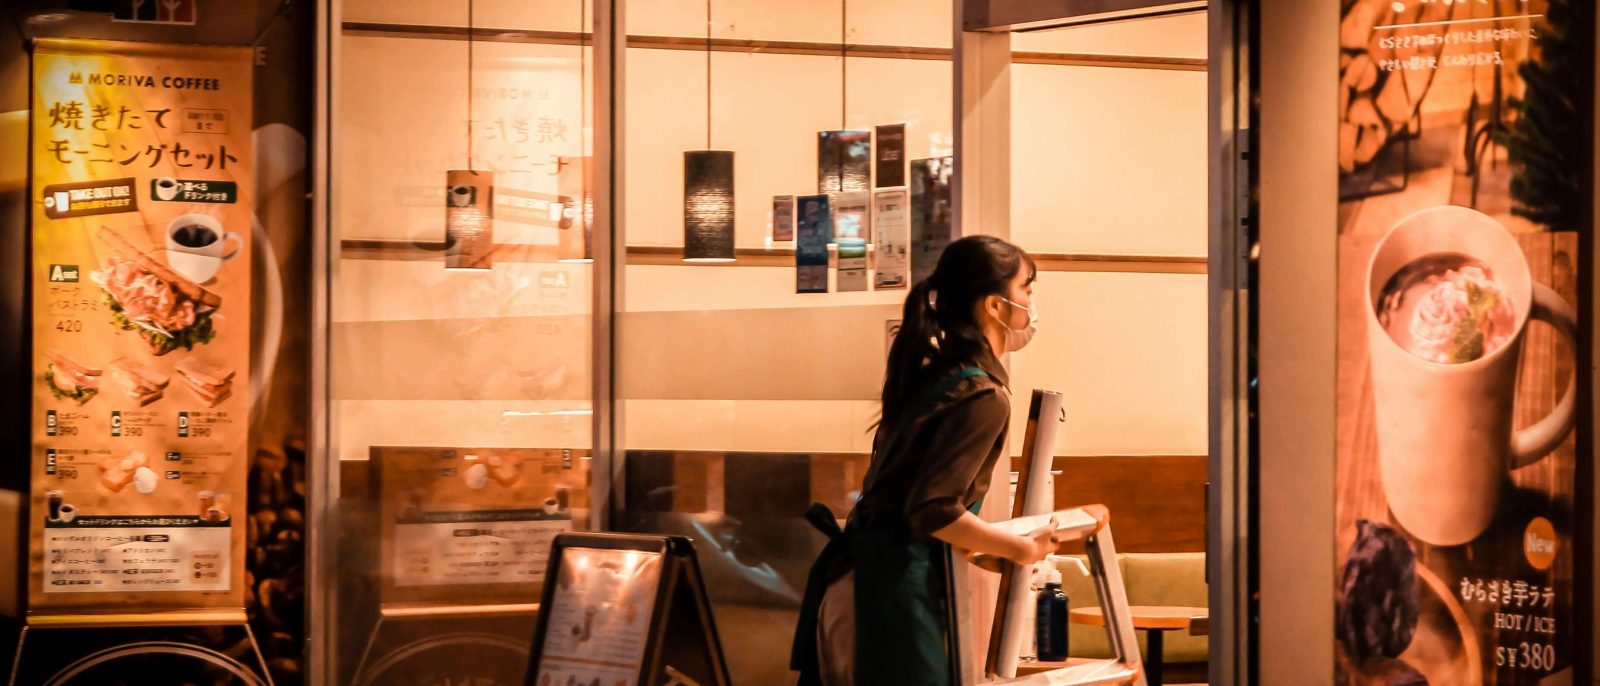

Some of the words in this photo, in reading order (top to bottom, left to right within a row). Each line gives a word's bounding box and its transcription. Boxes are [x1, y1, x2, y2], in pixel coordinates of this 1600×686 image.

[89, 73, 156, 88] MORIVA
[162, 76, 220, 91] COFFEE
[48, 100, 172, 131] 焼きたて
[47, 139, 238, 170] モーニングセット
[56, 320, 82, 333] 420
[1526, 532, 1556, 554] New
[1460, 576, 1555, 608] むらさき芋ラテ
[1494, 612, 1524, 631] HOT
[1534, 616, 1556, 634] ICE
